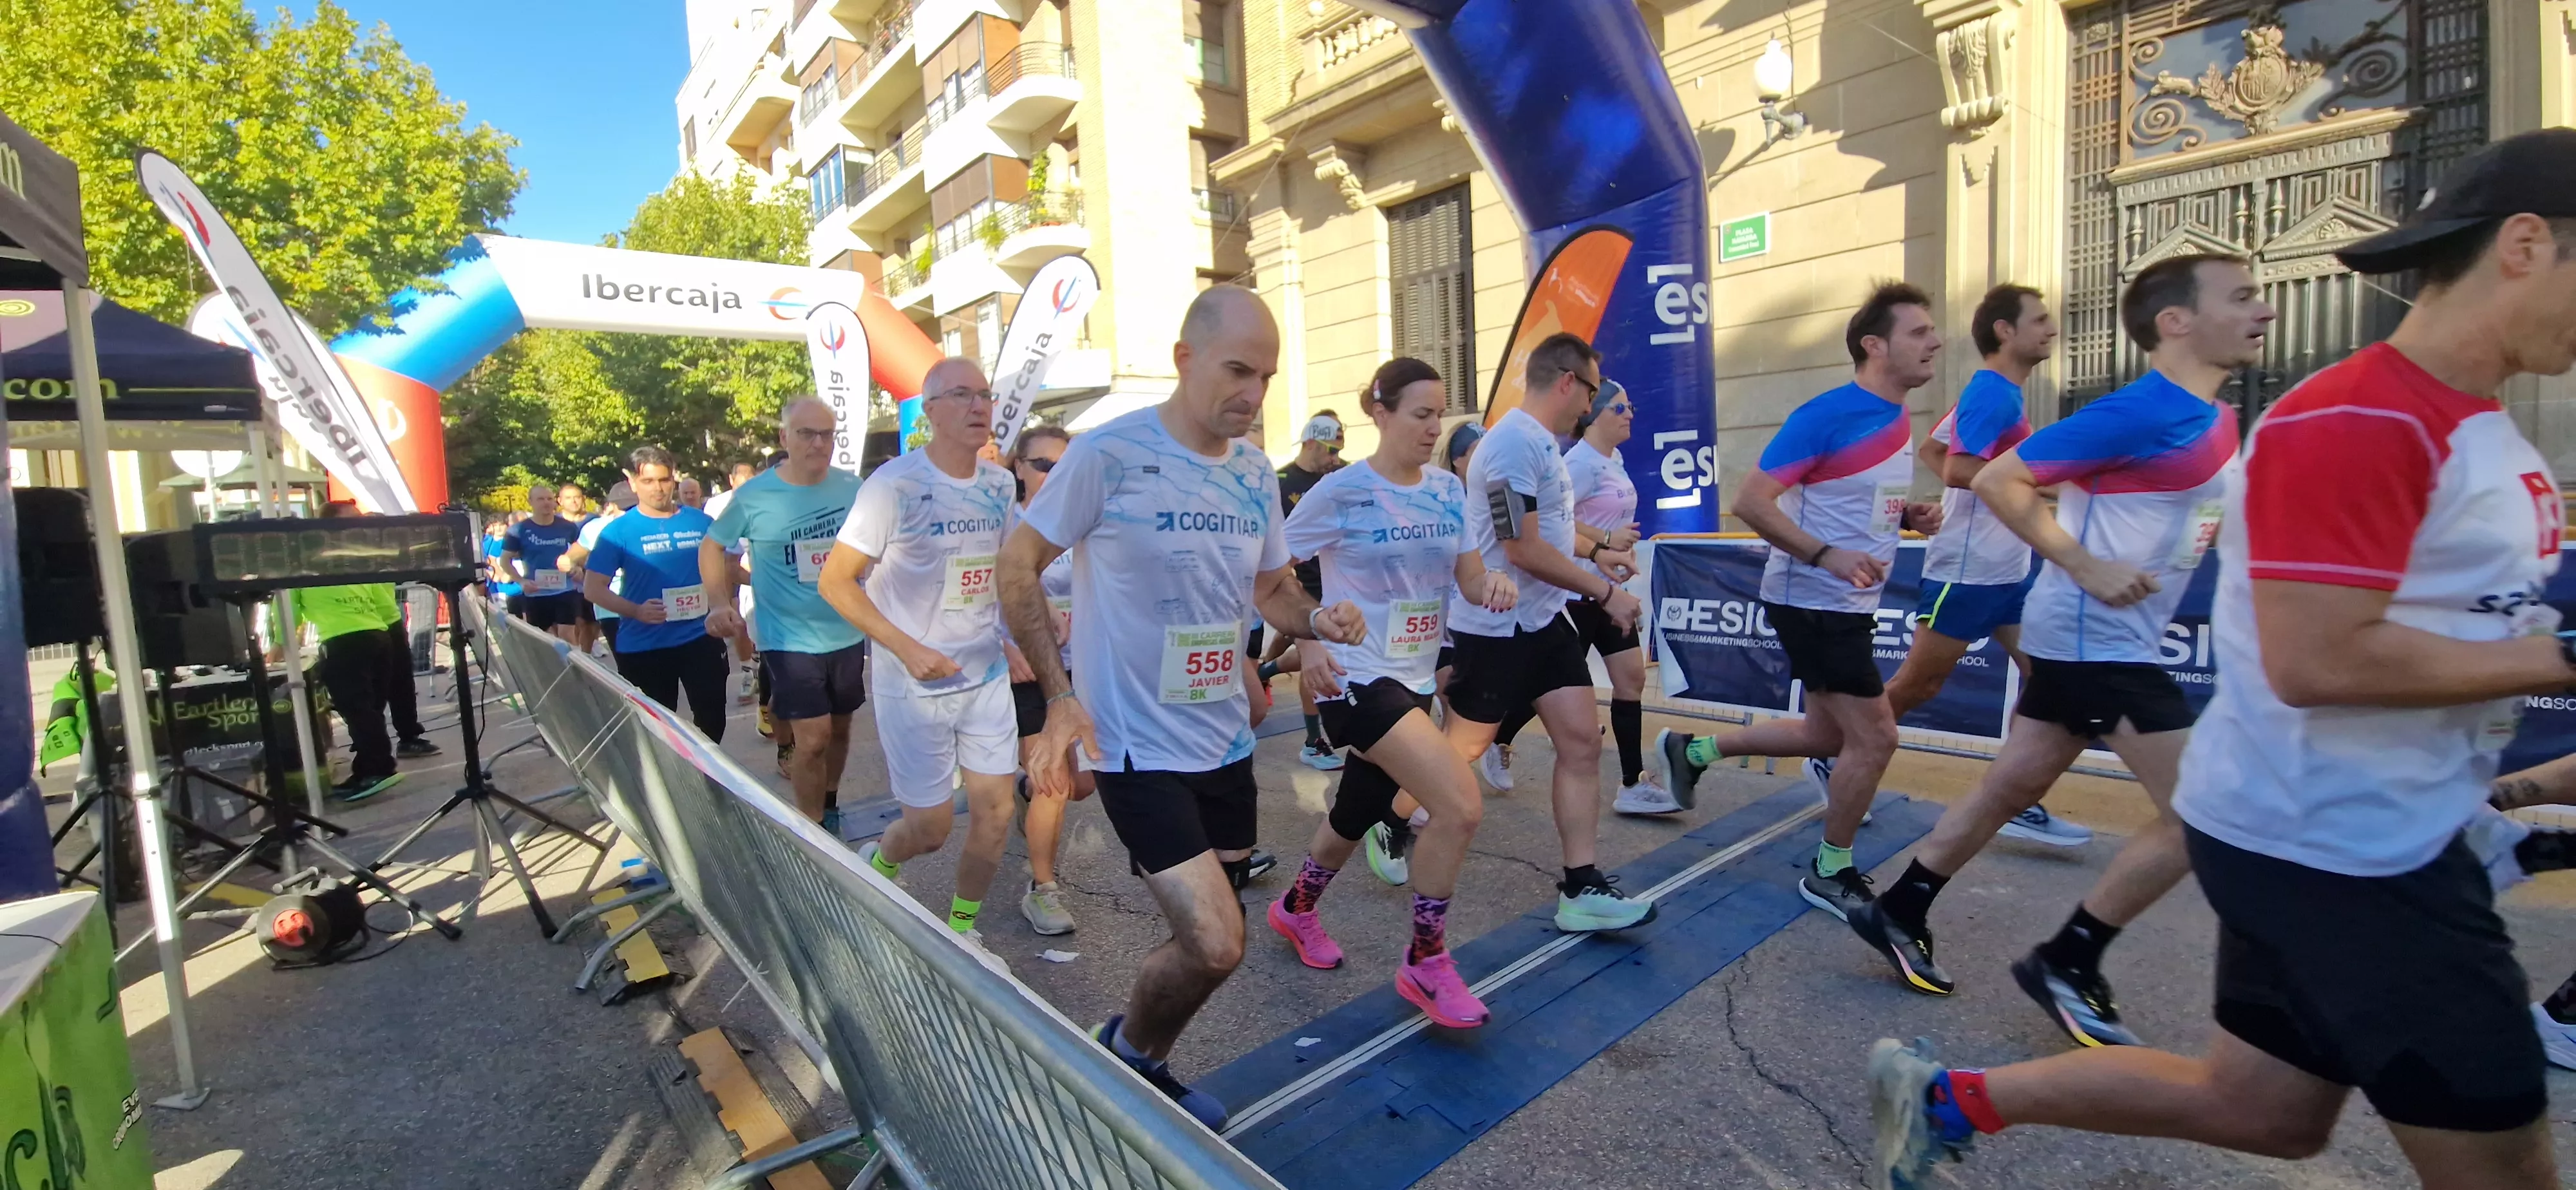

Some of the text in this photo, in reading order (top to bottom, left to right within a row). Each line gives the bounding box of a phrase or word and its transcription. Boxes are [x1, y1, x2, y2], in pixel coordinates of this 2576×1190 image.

[582, 274, 743, 313] Ibercaja
[804, 517, 836, 536] CARRERA
[1179, 511, 1258, 539] COGITIAR
[1391, 523, 1456, 541] COGITIAR
[961, 568, 993, 587] 557
[961, 585, 989, 596] CARLOS
[676, 594, 700, 607] 521
[1405, 614, 1438, 634] 559
[1391, 634, 1421, 644] LAURA
[1186, 649, 1234, 675] 558
[1188, 675, 1229, 688] JAVIER
[1189, 688, 1208, 701] 8K
